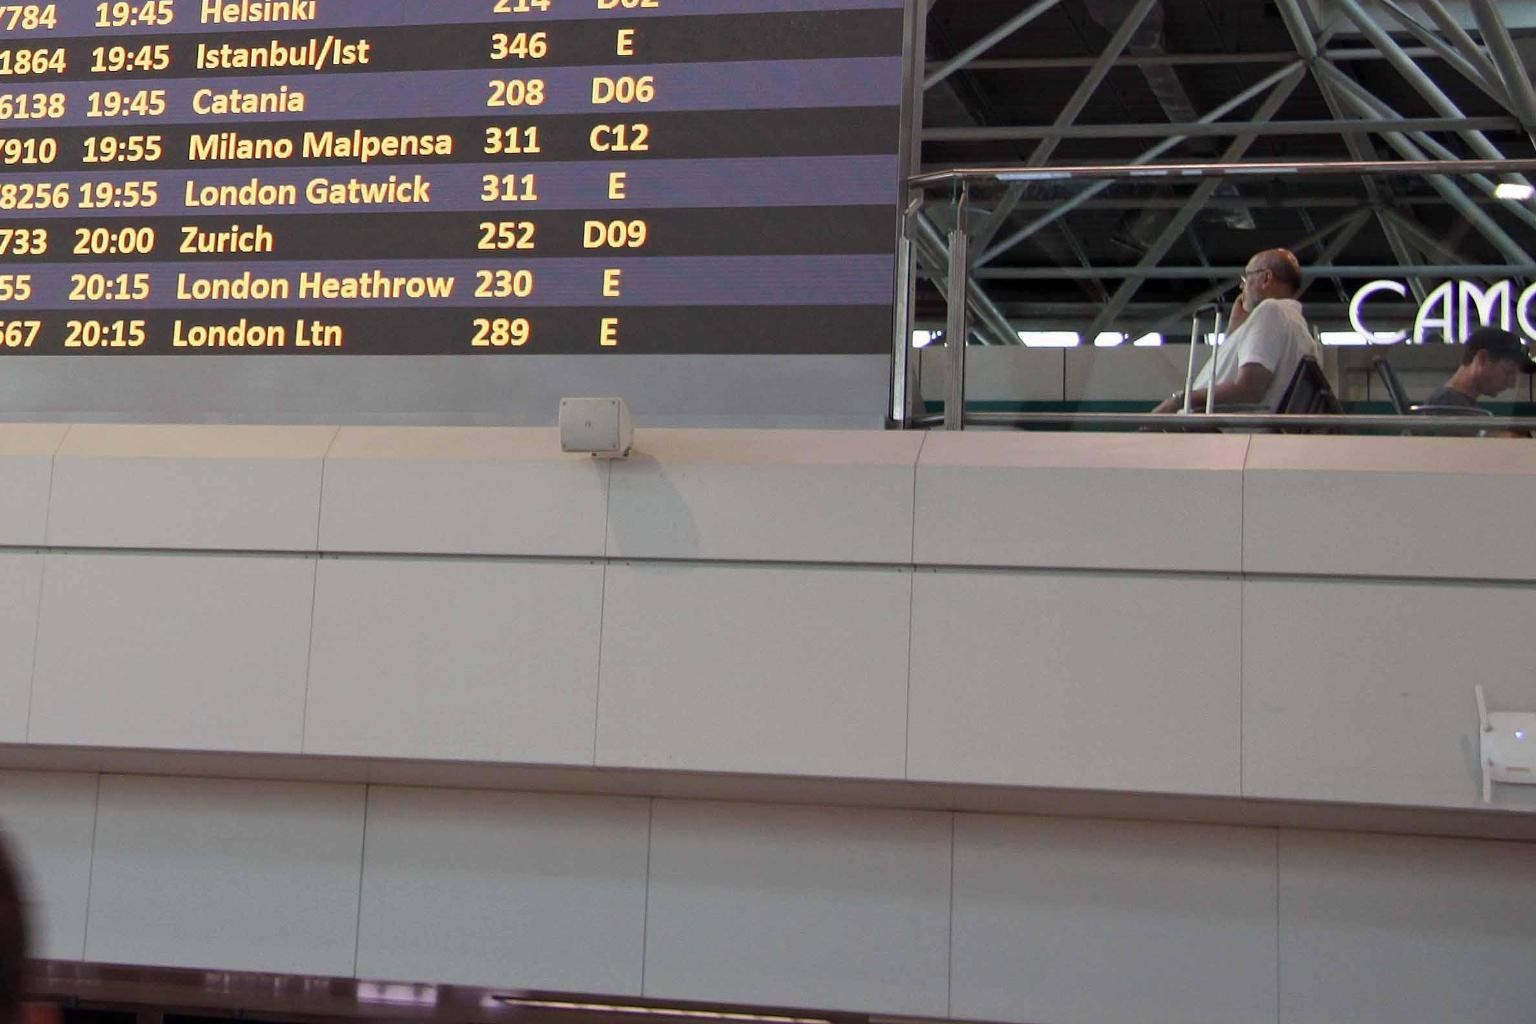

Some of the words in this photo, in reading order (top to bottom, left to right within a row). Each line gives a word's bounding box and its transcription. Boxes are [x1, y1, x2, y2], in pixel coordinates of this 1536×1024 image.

[89, 43, 171, 74] 19:45
[195, 34, 372, 72] Istanbul/Ist
[488, 30, 549, 61] 346
[615, 27, 635, 57] E
[85, 88, 168, 119] 19:45
[191, 83, 308, 116] Catania
[485, 77, 547, 108] 208
[590, 74, 657, 106] D06
[76, 179, 160, 210] 19:55
[183, 176, 299, 208] London
[304, 173, 433, 206] Gatwick
[480, 172, 539, 203] 311
[607, 170, 629, 200] E
[67, 272, 151, 302] 20:15
[175, 271, 291, 302] London
[297, 268, 456, 301] Heathrow
[472, 268, 536, 299] 230
[601, 267, 623, 298] E
[62, 318, 147, 349] 20:15
[171, 316, 287, 348] London
[294, 317, 344, 348] Ltn
[470, 316, 531, 348] 289
[598, 316, 619, 347] E
